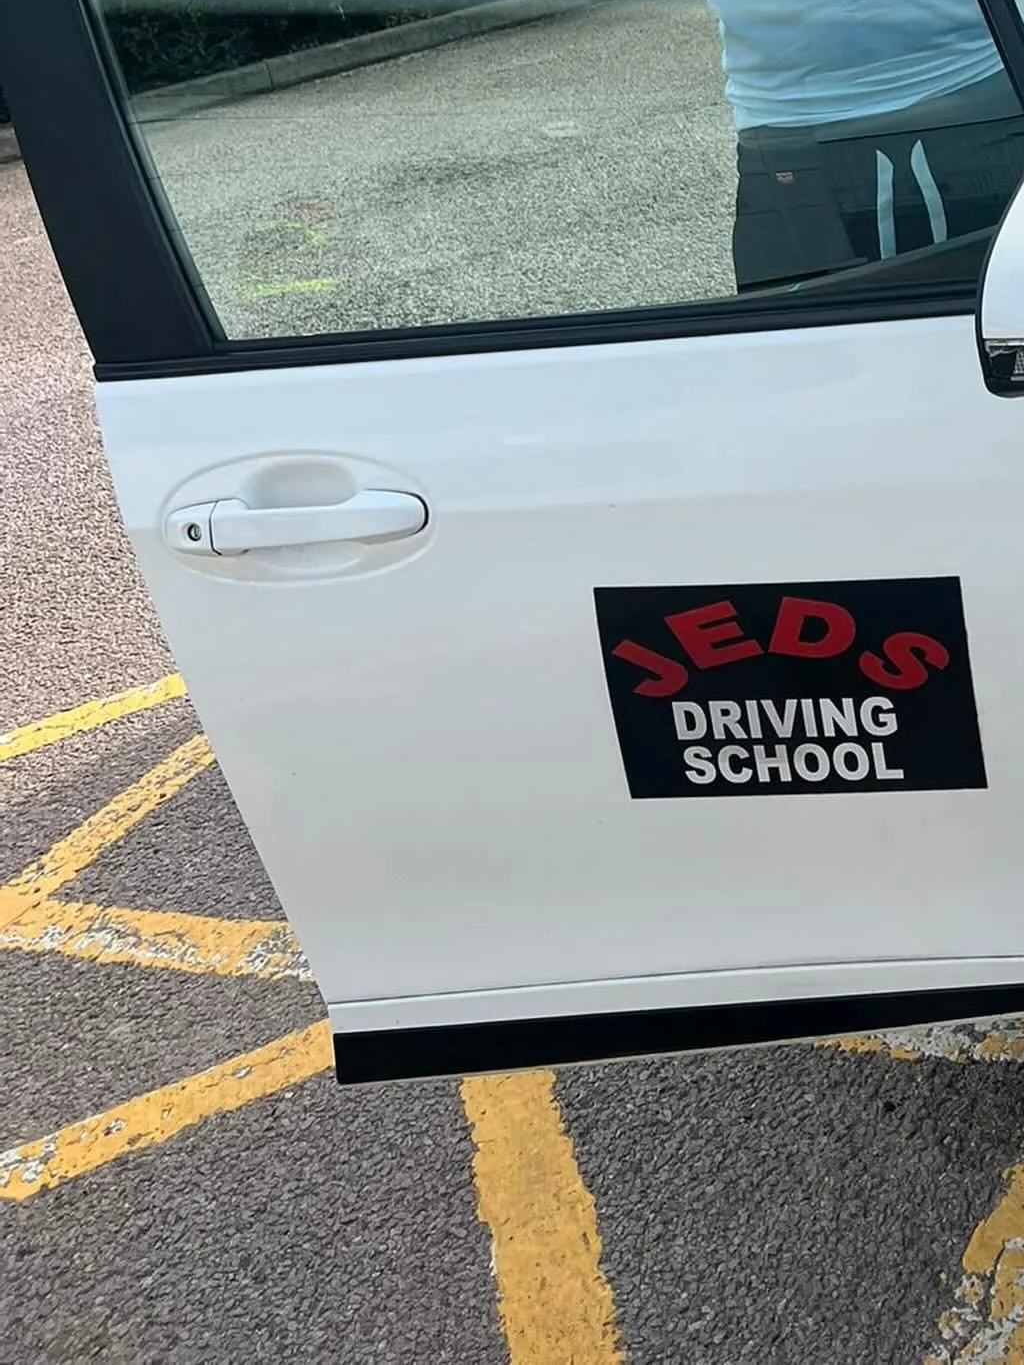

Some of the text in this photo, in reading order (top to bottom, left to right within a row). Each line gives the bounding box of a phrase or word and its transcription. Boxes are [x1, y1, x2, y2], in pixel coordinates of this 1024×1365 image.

[611, 596, 950, 698] JEDS
[671, 696, 898, 741] DRIVING
[683, 742, 905, 785] SCHOOL
